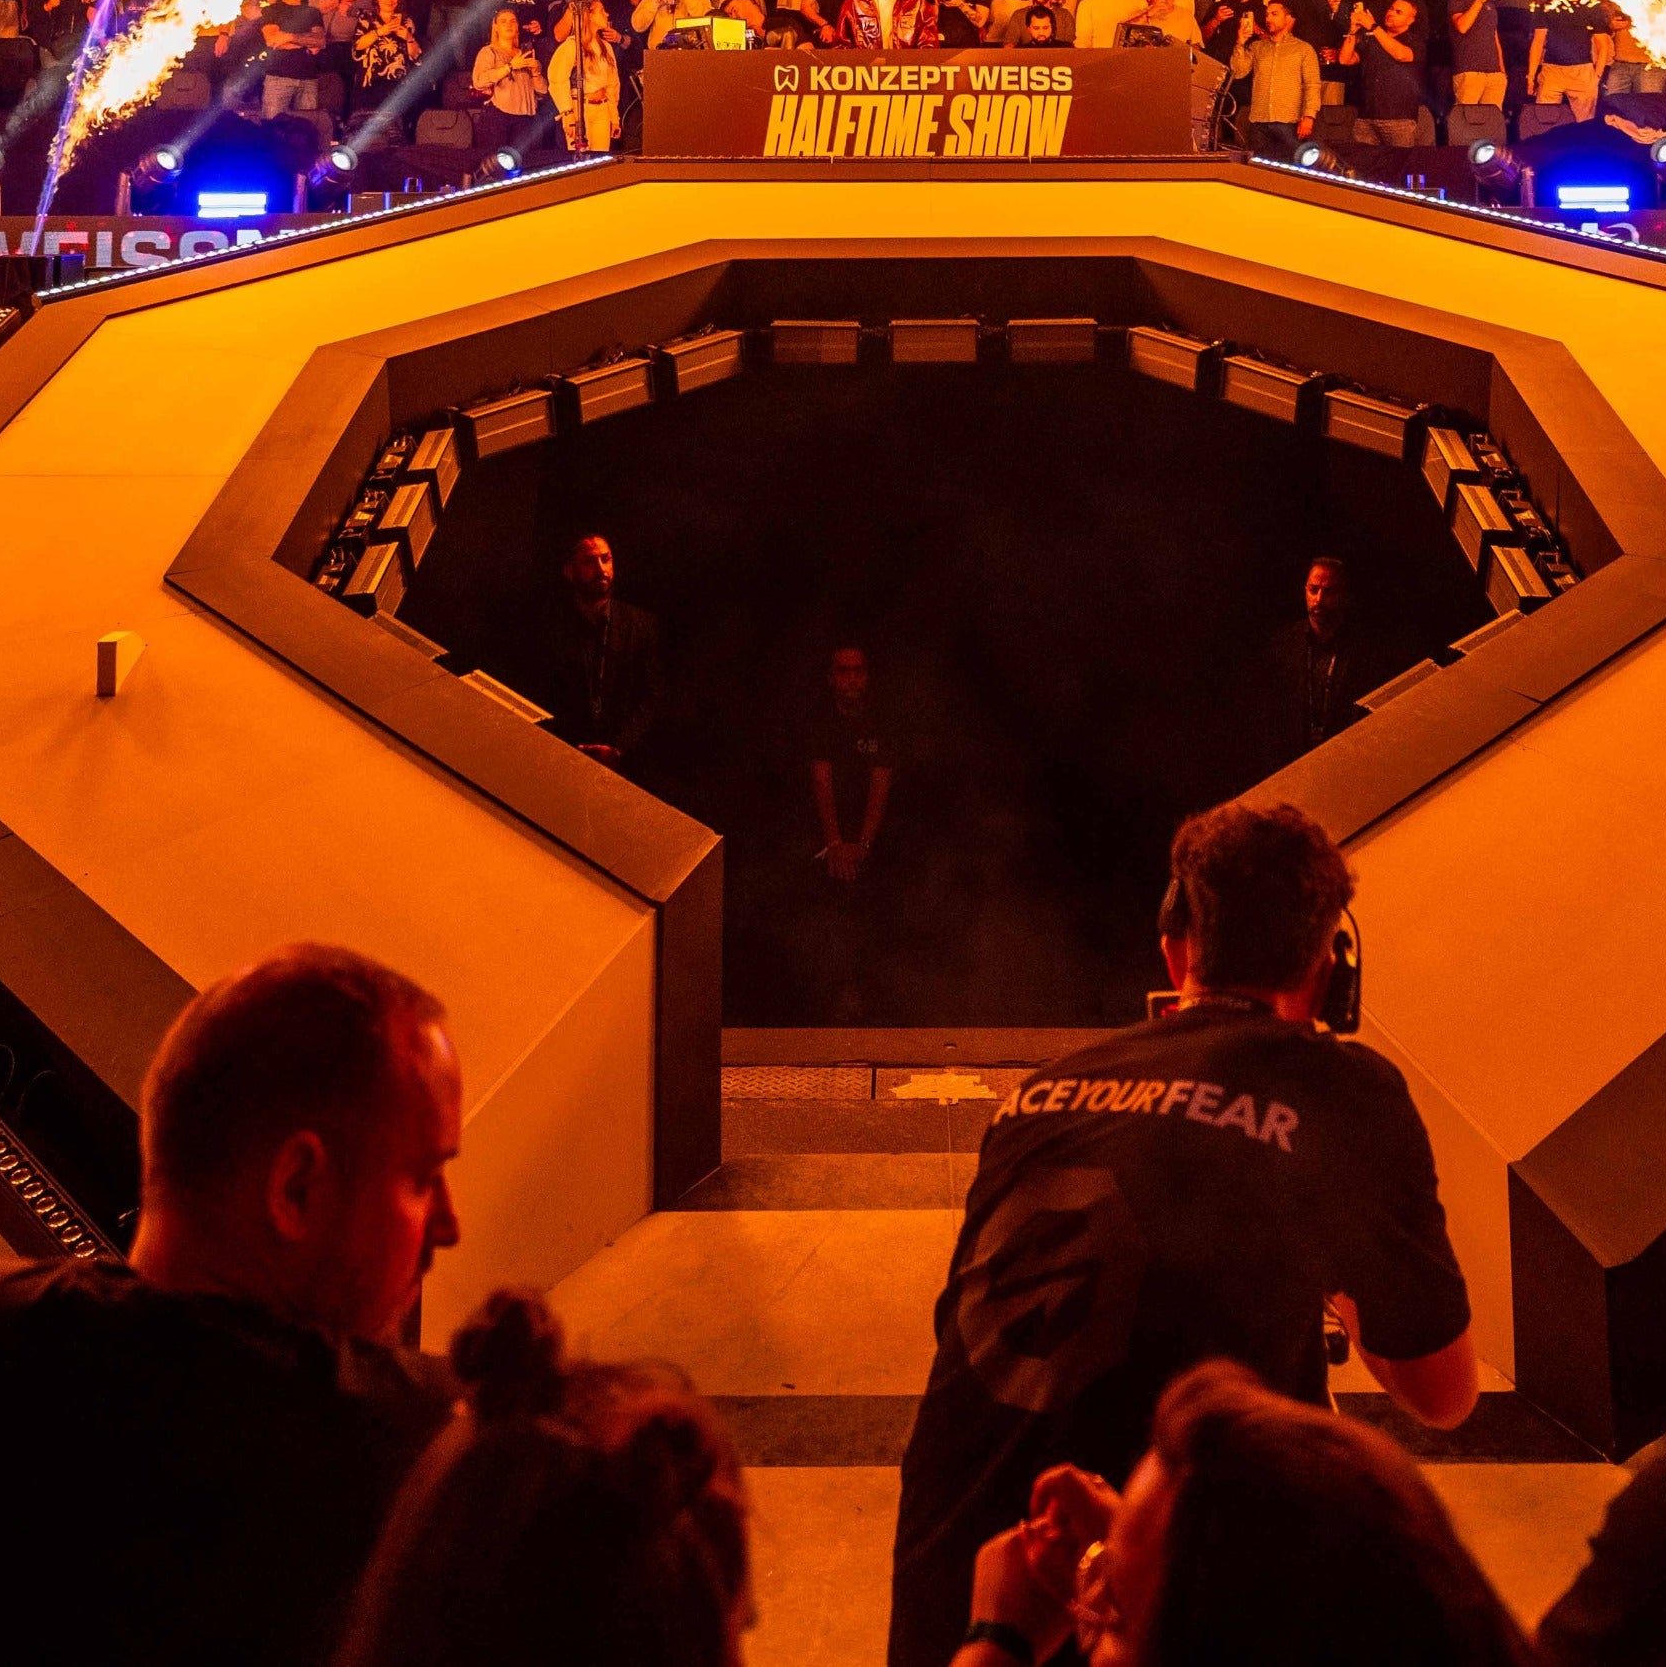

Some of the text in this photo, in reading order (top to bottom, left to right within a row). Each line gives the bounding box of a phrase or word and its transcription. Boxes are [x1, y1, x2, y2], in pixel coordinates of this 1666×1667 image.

[811, 66, 1073, 91] KONZEPT WEISS
[763, 95, 1072, 156] HALFTIME SHOW
